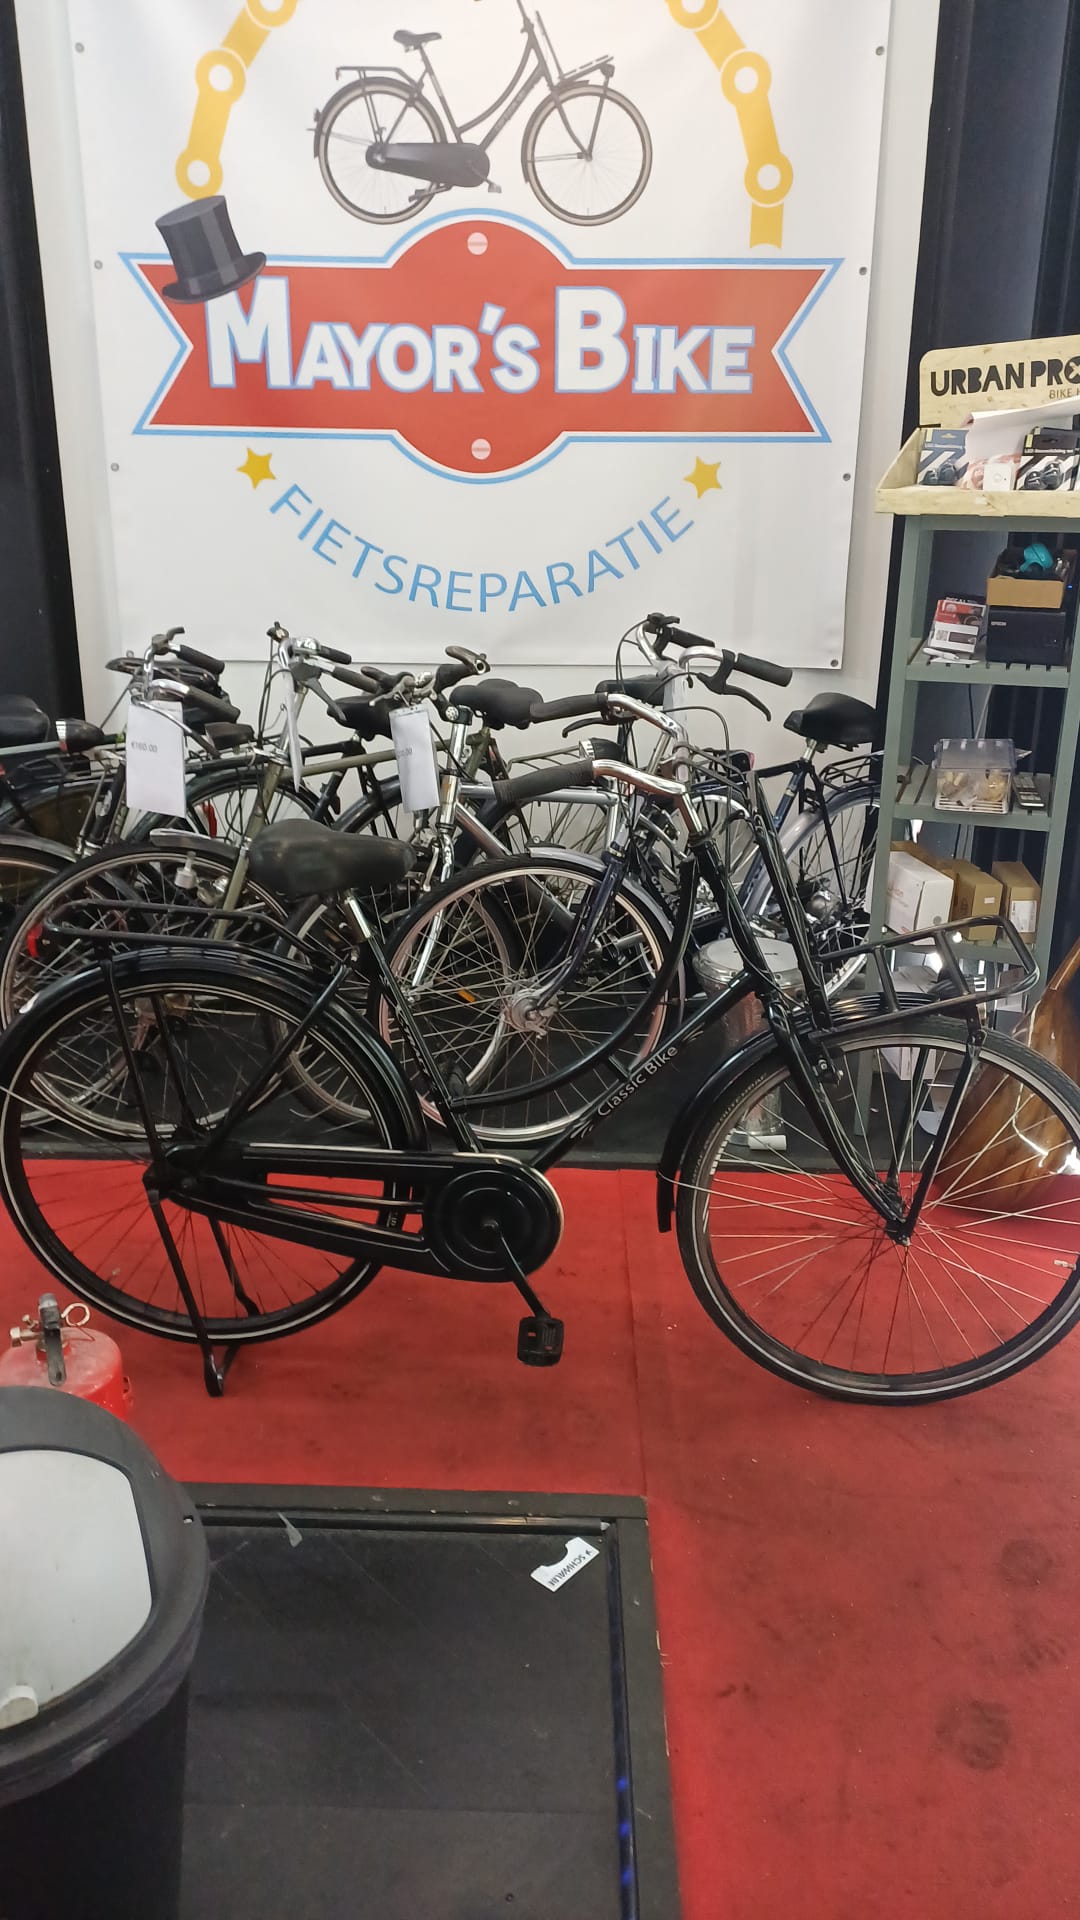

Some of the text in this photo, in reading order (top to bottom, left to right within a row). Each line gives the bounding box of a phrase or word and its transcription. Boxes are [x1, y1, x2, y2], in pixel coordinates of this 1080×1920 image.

[554, 286, 755, 394] BIKE
[930, 362, 1025, 396] URBAN
[1049, 388, 1072, 400] BIKE
[268, 484, 693, 613] FIETSREPARATIE
[597, 1046, 678, 1116] Classic Bike
[547, 1553, 586, 1586] SCHWALBE
